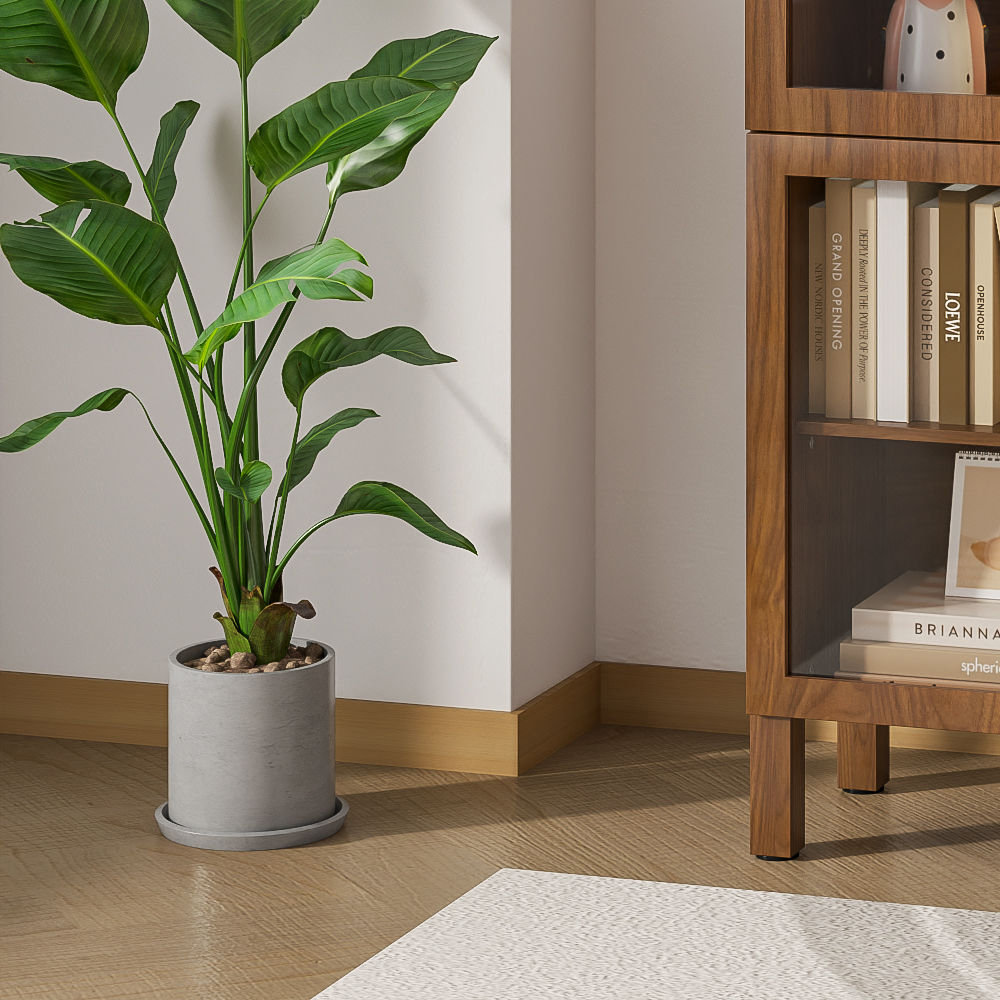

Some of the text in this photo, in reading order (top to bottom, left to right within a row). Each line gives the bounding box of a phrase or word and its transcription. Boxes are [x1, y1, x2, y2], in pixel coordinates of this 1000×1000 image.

[858, 228, 869, 258] DEEPLY
[831, 232, 843, 351] GRAND OPENING
[858, 295, 869, 309] THE
[858, 312, 869, 340] POWER
[921, 267, 933, 361] CONSIDERED
[944, 291, 961, 343] LOEWE
[976, 284, 985, 341] OPENHOUSE
[858, 341, 869, 353] OF
